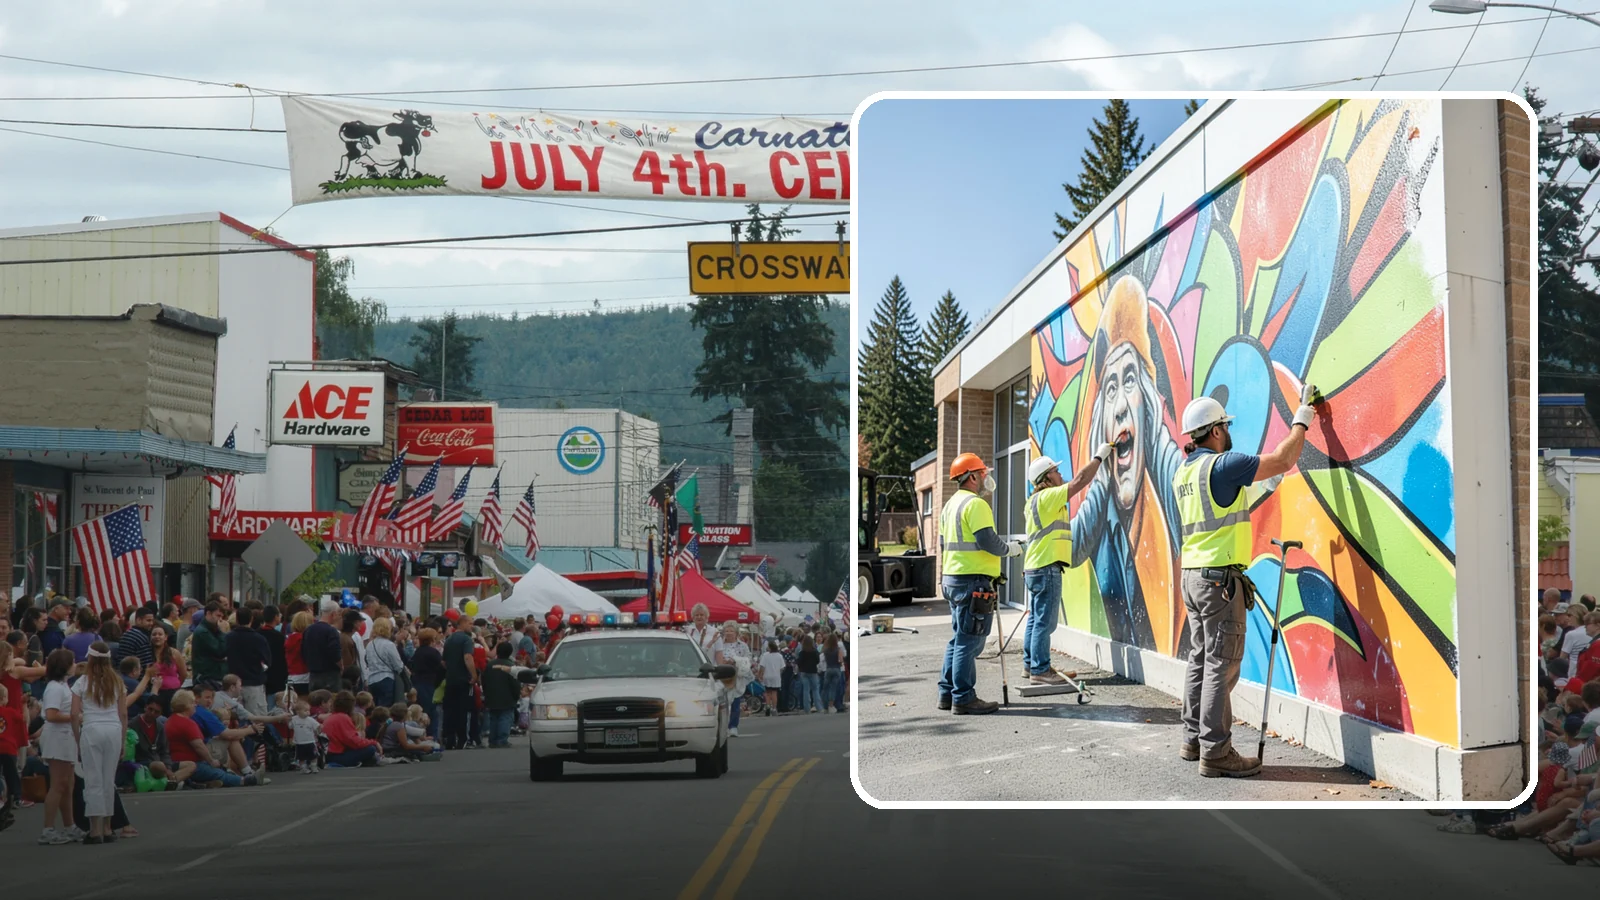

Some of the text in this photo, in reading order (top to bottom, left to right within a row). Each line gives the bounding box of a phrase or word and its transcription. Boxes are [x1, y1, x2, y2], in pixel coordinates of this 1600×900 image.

[695, 121, 850, 149] Carnat
[481, 141, 605, 192] JULY
[632, 150, 746, 198] 4th.
[697, 254, 850, 280] CROSSWA
[283, 380, 373, 420] ACE
[405, 409, 485, 422] CEDAR LOG
[284, 421, 371, 436] Hardware
[96, 485, 124, 495] Vincent
[126, 486, 136, 495] de
[138, 486, 155, 495] Paul
[688, 526, 741, 535] CRNATION
[699, 535, 731, 544] GLASS
